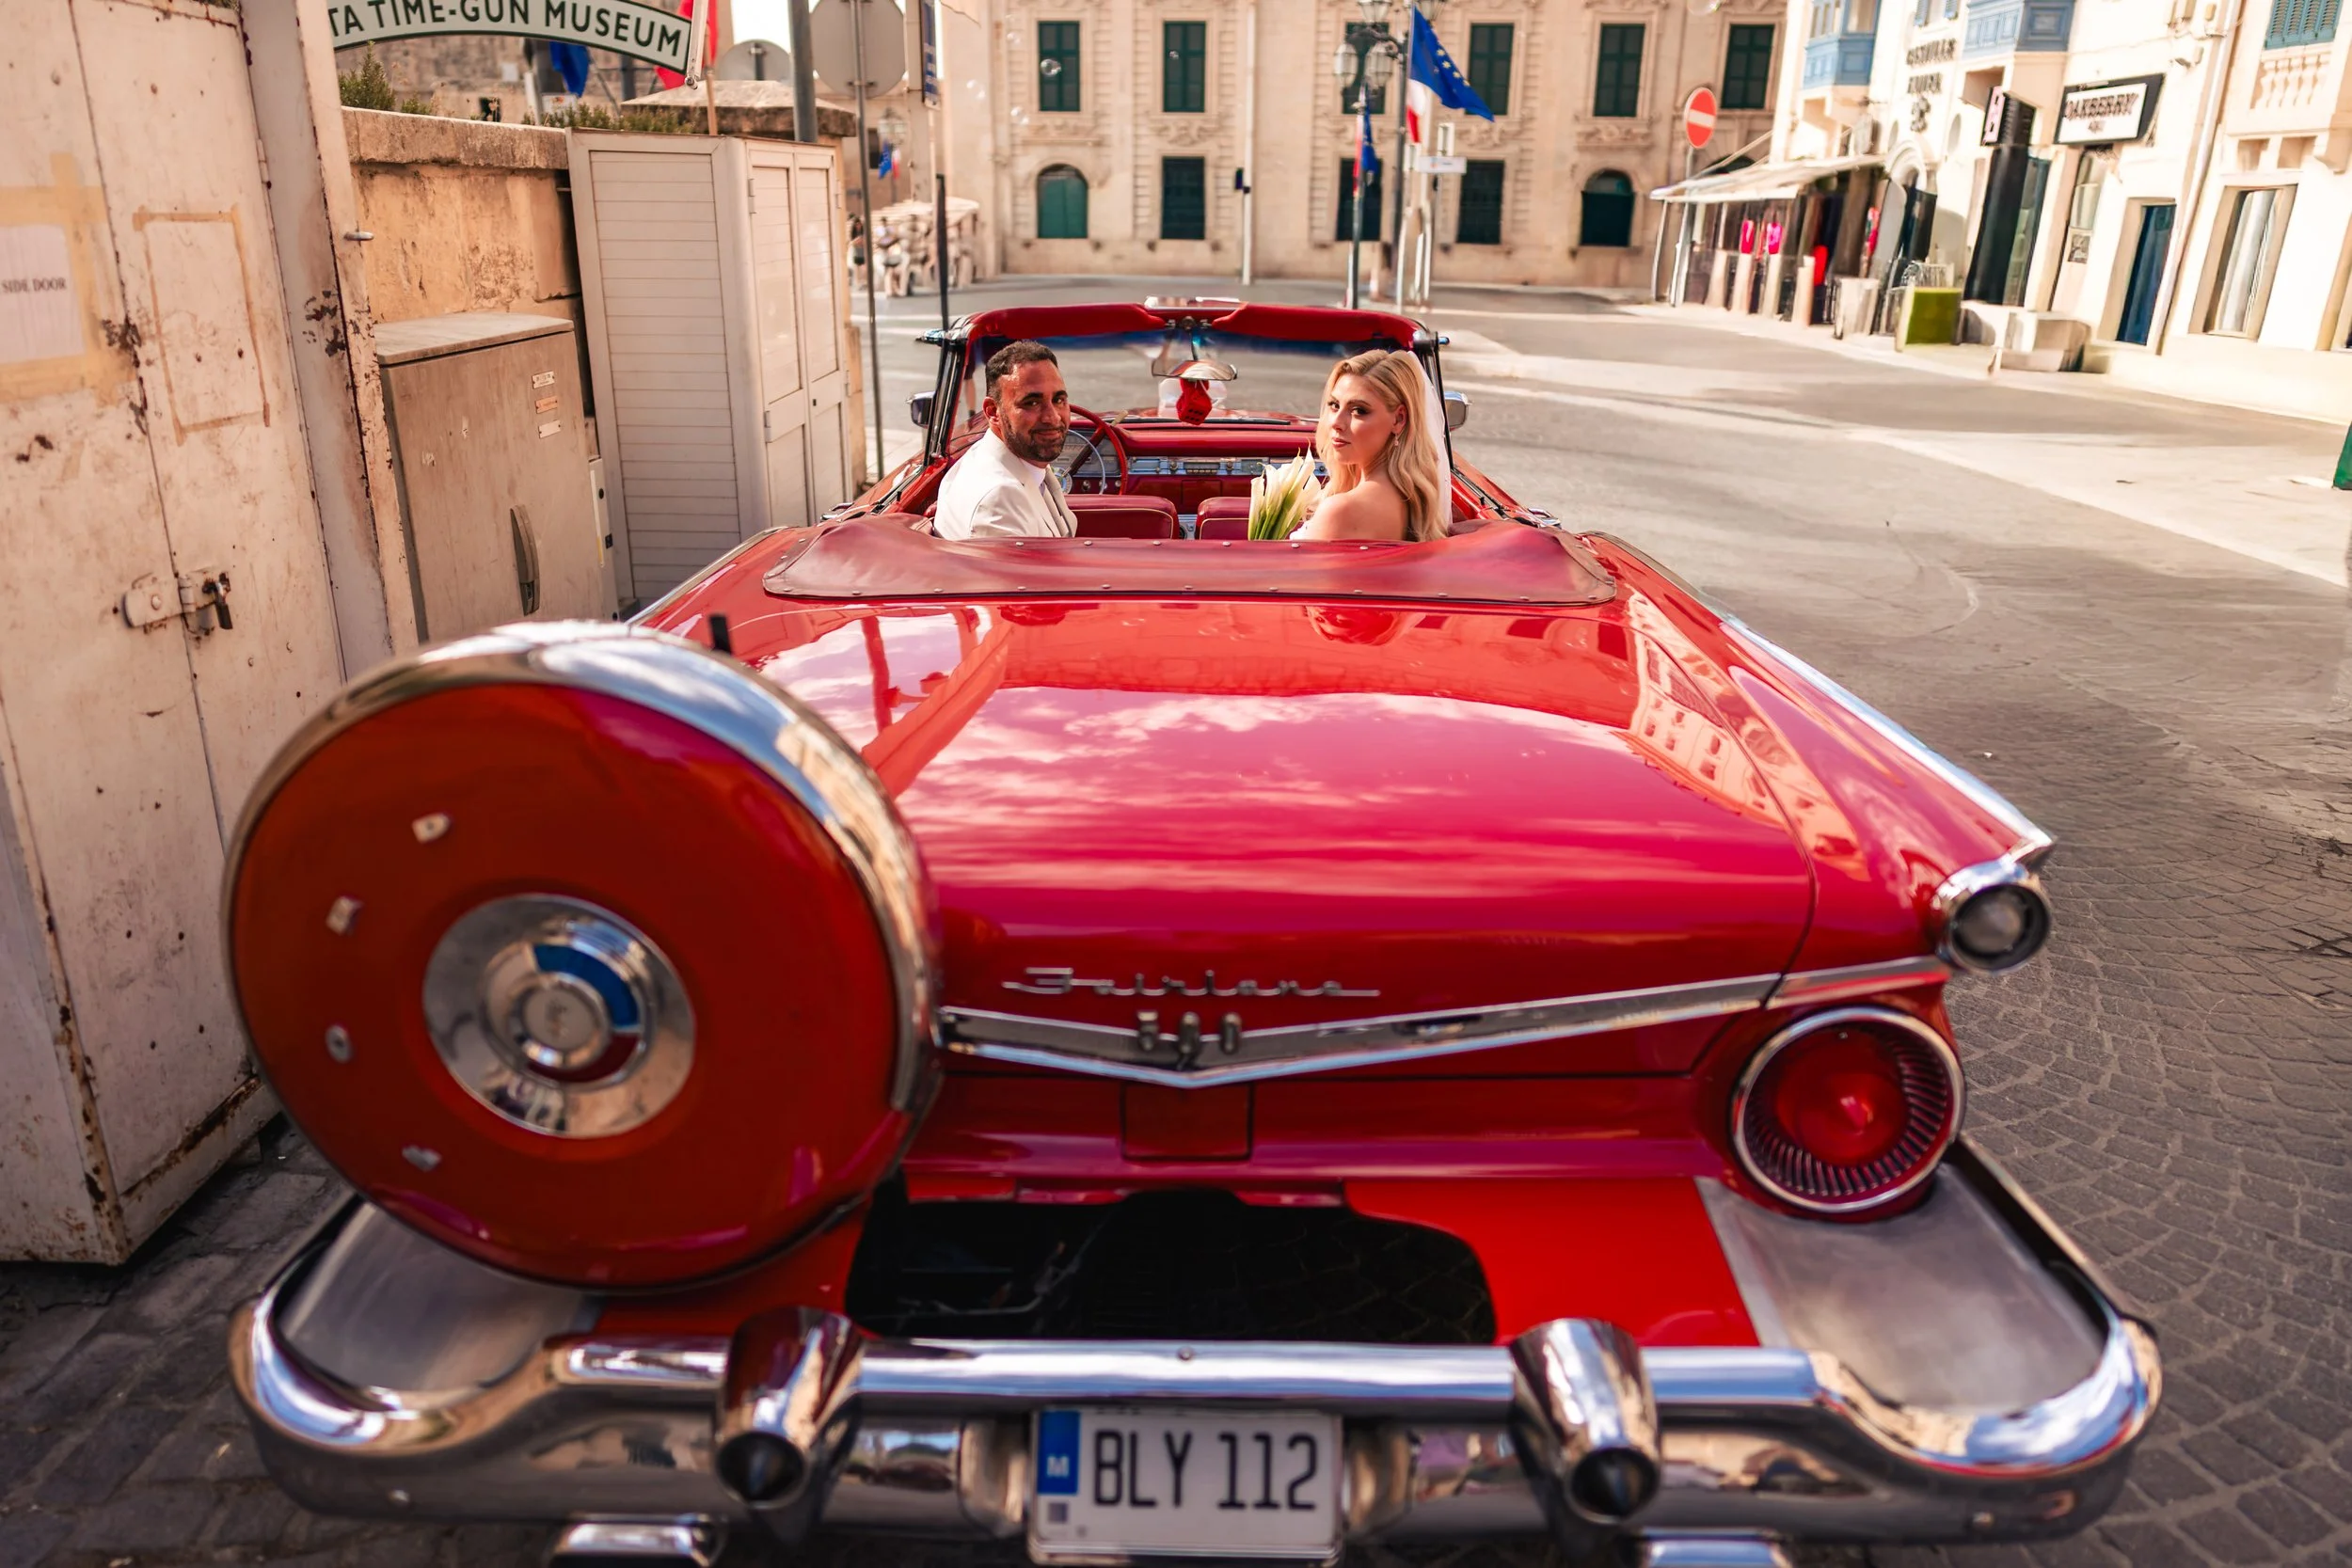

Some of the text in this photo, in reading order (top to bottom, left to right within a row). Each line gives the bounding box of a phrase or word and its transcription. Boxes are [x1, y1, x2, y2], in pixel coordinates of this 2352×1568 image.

[368, 0, 530, 28] TIME-GUN
[545, 0, 682, 56] MUSEUM
[1, 277, 67, 293] SIDE DOOR
[1045, 1455, 1070, 1478] M
[1093, 1430, 1318, 1512] BLY 112
